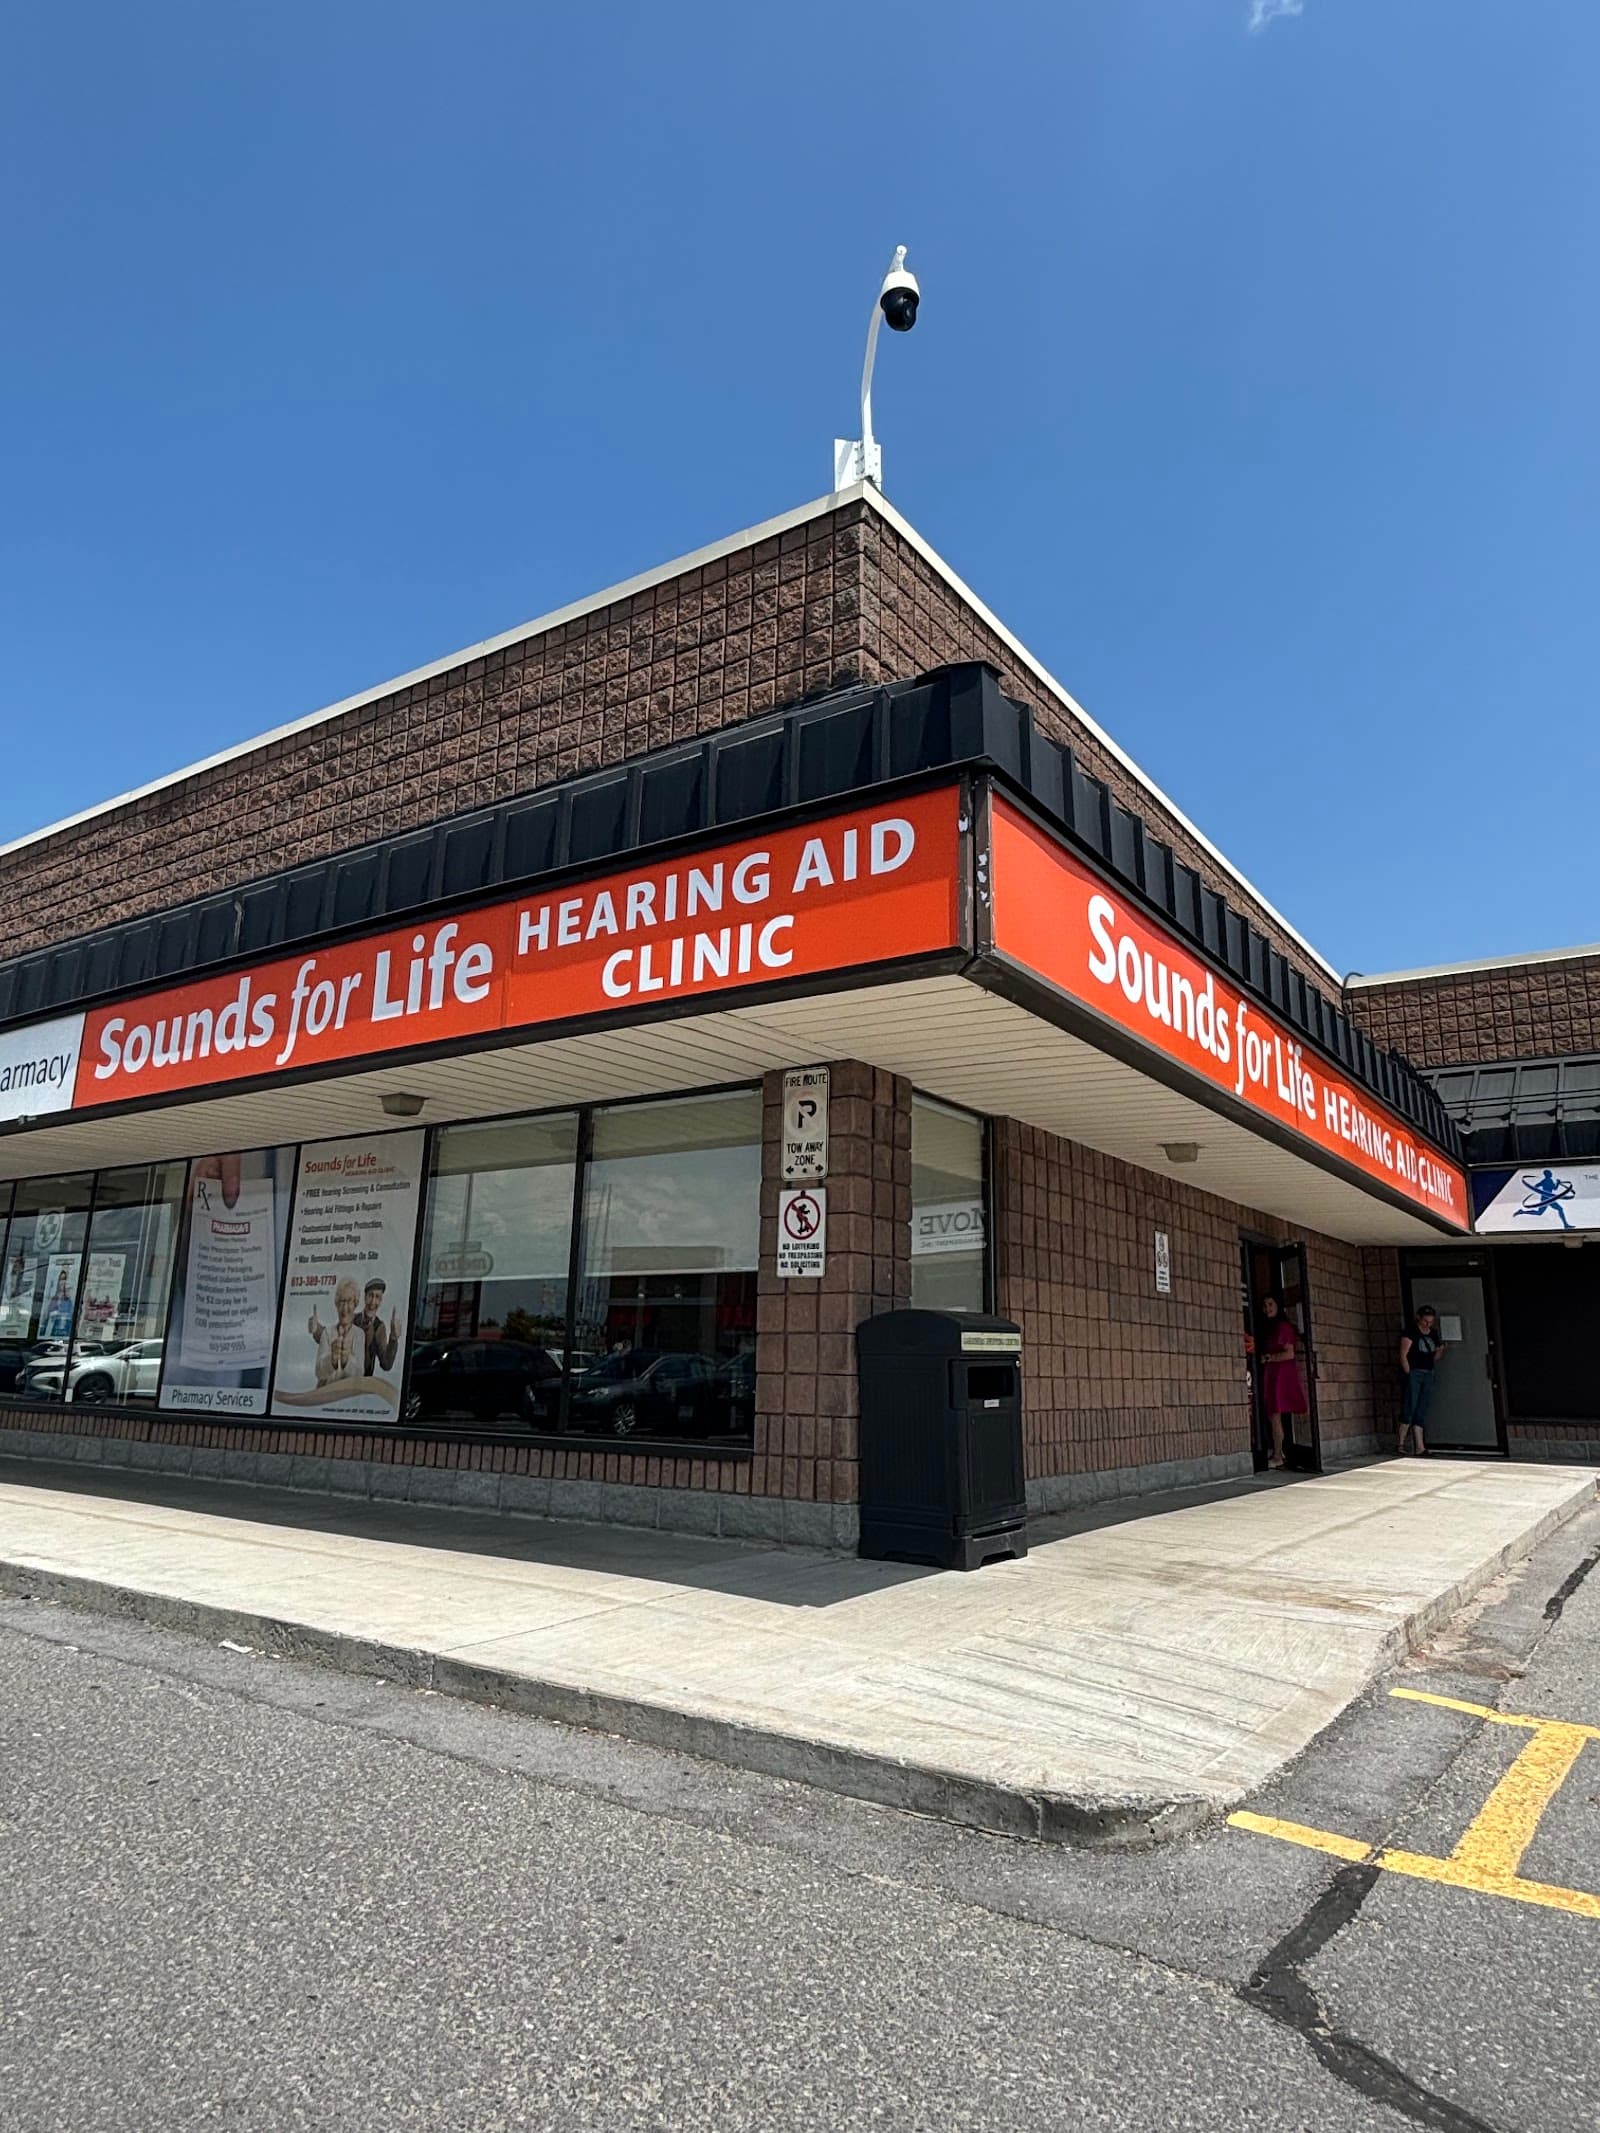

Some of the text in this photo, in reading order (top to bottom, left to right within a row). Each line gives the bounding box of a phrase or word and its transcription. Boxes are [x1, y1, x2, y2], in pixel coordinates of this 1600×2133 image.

[517, 818, 916, 956] HEARING AID
[601, 915, 796, 999] CLINIC
[94, 922, 493, 1080] Sounds for Life
[1087, 894, 1453, 1206] Sounds for Life HEARING AID CLINIC
[0, 1053, 71, 1092] armacy
[786, 1073, 827, 1087] FIRE ROUTE
[787, 1141, 824, 1154] TOW AWAY
[304, 1152, 377, 1174] Sounds for Life
[794, 1154, 816, 1166] ZONE
[306, 1188, 320, 1198] FREE
[792, 1242, 820, 1250] LOITERING
[788, 1251, 823, 1259] TRESPASSING
[790, 1261, 820, 1269] SOLICITING
[172, 1389, 254, 1407] Pharmacy Services
